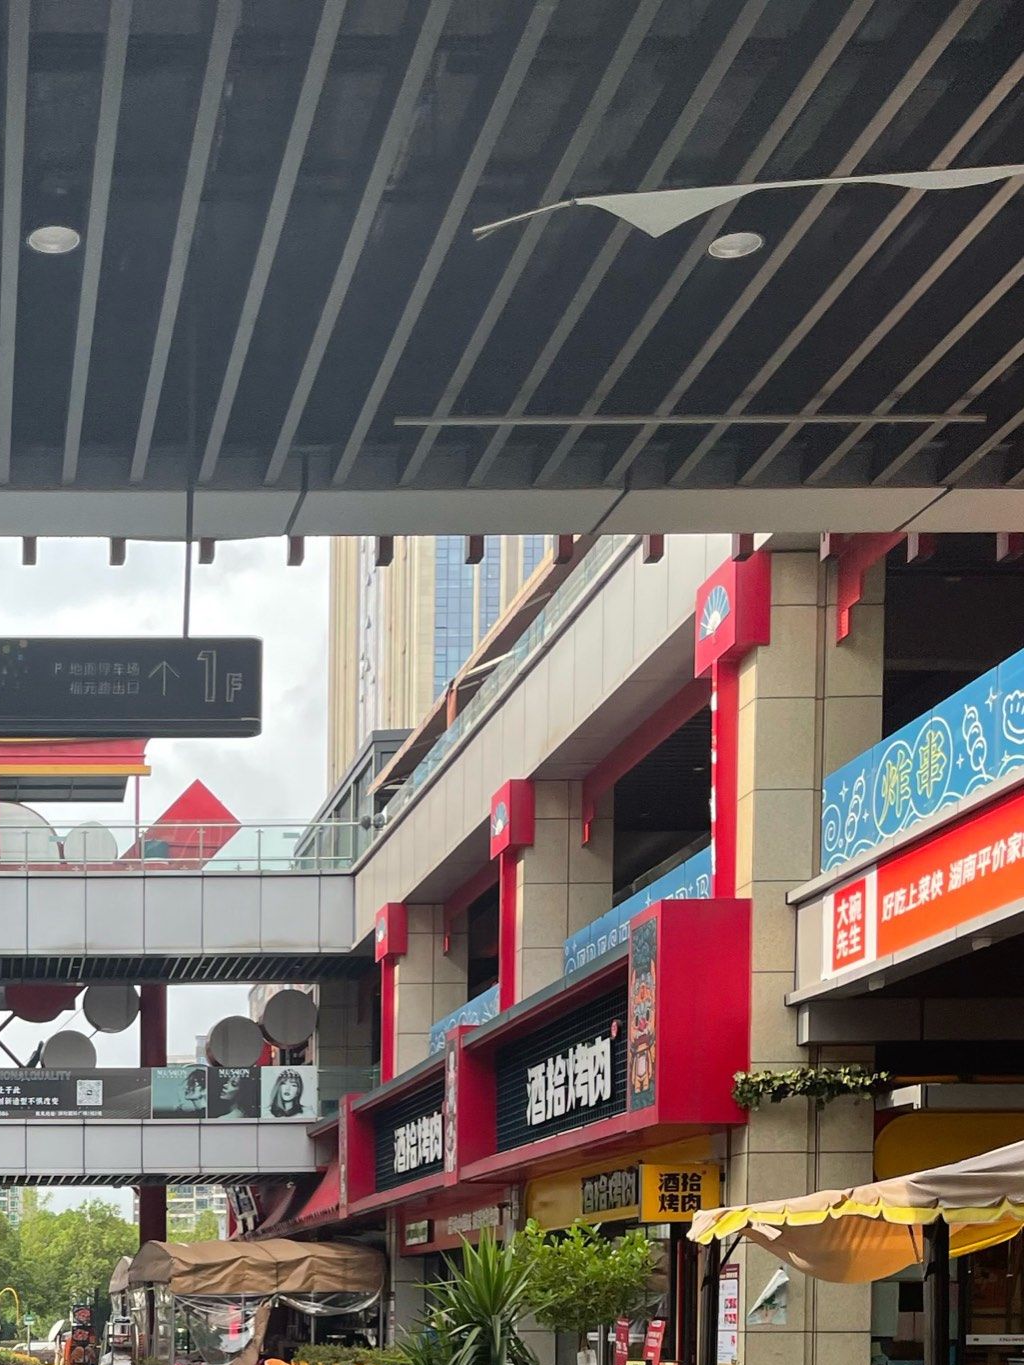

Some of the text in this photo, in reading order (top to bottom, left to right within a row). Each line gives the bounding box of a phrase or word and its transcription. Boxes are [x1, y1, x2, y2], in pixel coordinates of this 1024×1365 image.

[55, 662, 140, 675] P 地面停车场
[878, 730, 947, 827] 炸串
[837, 892, 863, 930] 大碗
[881, 868, 944, 923] 好吃上菜快
[836, 924, 862, 960] 先生
[526, 1035, 612, 1126] 酒拾烤肉
[393, 1111, 443, 1174] 酒拾烤肉
[658, 1172, 702, 1193] 酒拾
[658, 1193, 702, 1213] 烤肉
